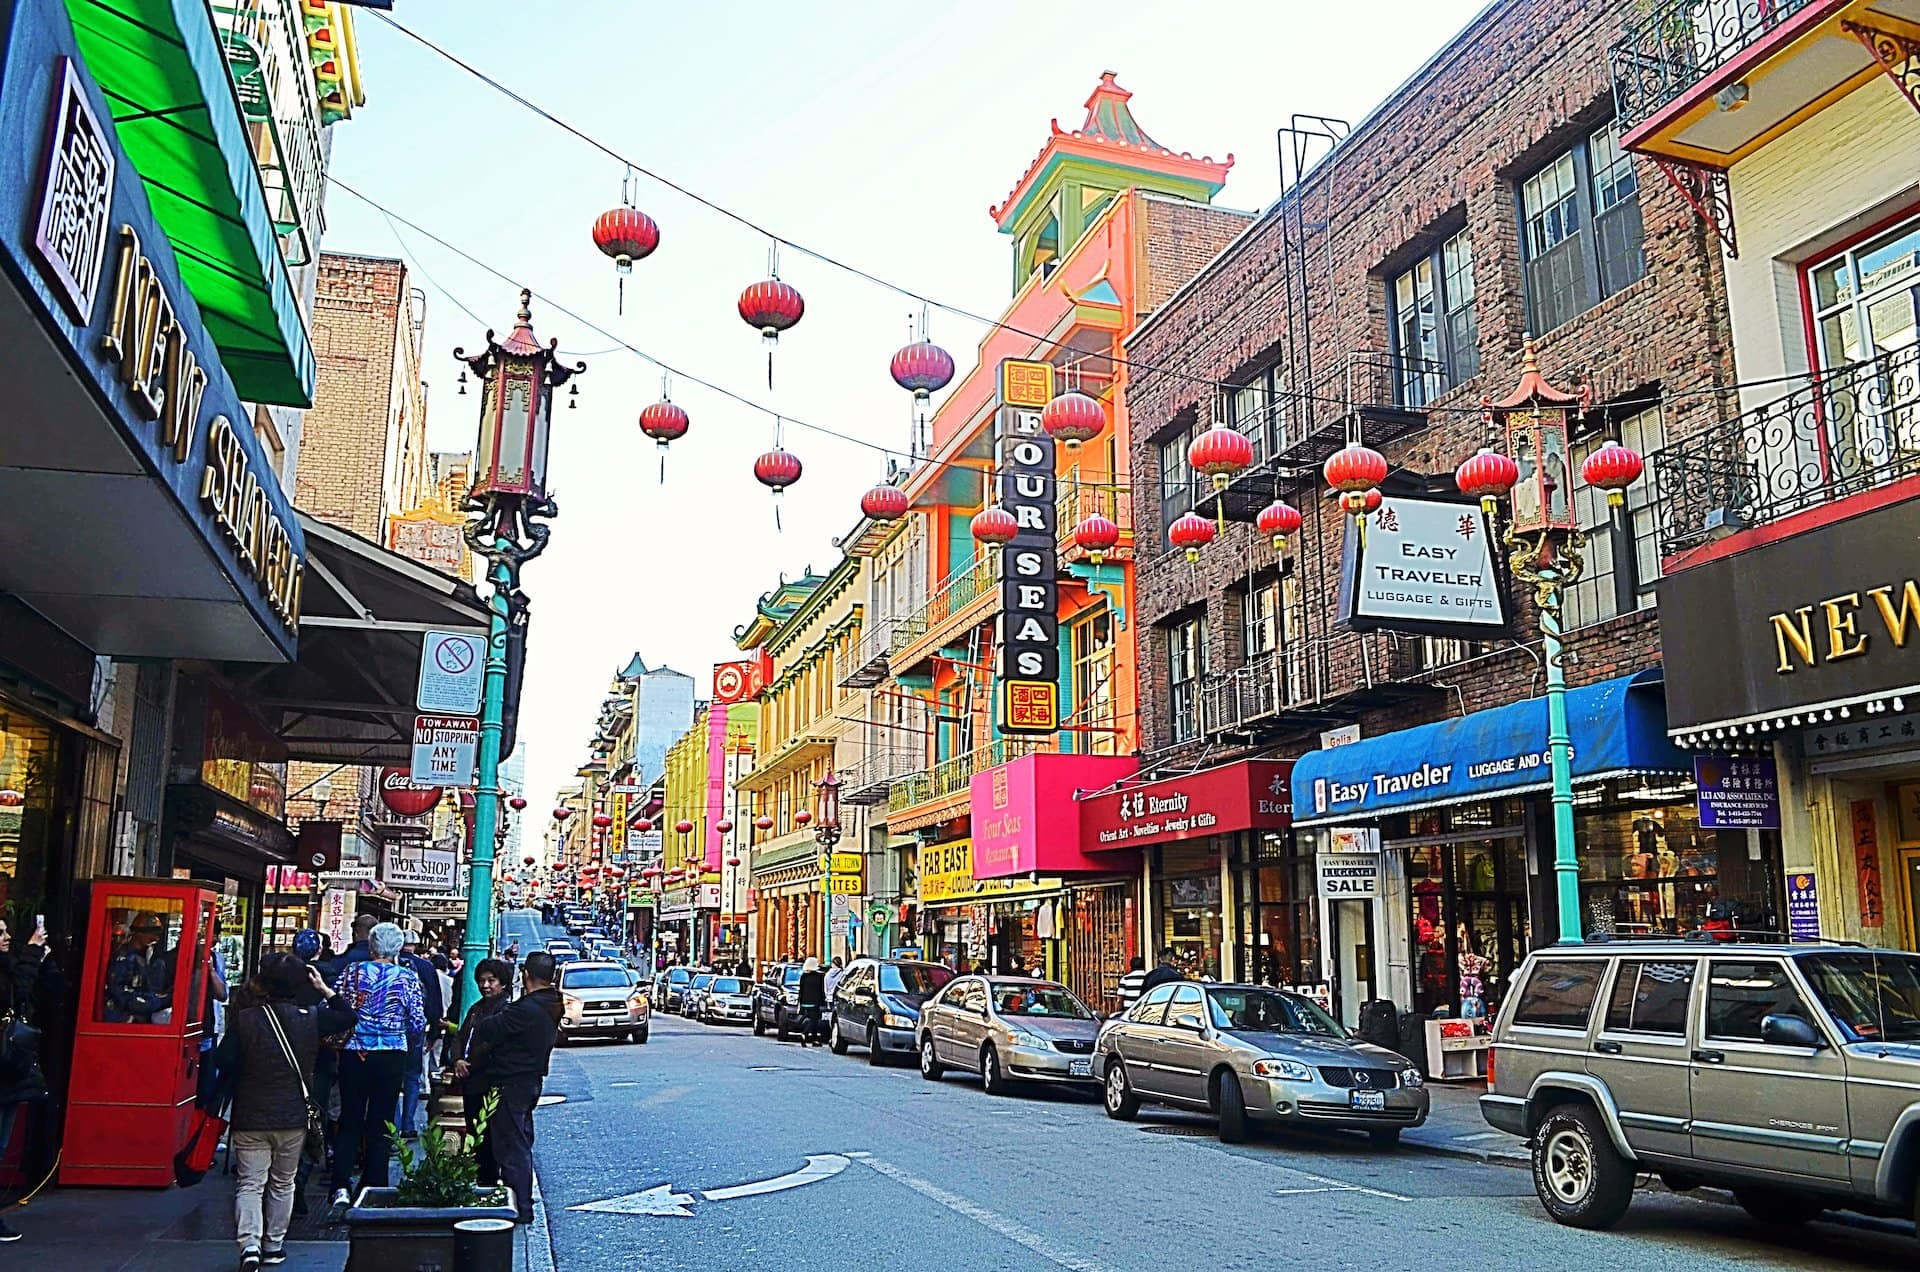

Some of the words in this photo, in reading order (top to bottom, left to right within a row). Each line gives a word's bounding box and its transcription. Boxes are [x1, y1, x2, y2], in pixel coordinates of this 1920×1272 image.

[102, 224, 207, 464] NEW
[1014, 411, 1046, 531] FOUR
[1402, 543, 1457, 560] EASY
[1375, 566, 1482, 587] TRAVELER
[1368, 591, 1433, 604] LUGGAGE
[1440, 595, 1449, 605] &
[1456, 597, 1493, 608] GIFTS
[1016, 552, 1048, 675] SEAS
[422, 718, 473, 729] TOW-AWAY
[415, 728, 431, 743] NO
[435, 730, 475, 744] STOPPING
[433, 746, 457, 758] ANY
[430, 759, 457, 772] TIME
[1469, 759, 1515, 778] LUGGAGE
[1518, 753, 1540, 769] AND
[1330, 780, 1370, 804] Easy
[1373, 764, 1451, 795] Traveler
[1149, 792, 1188, 814] Eternity
[1713, 792, 1726, 800] AND
[1100, 830, 1117, 842] Orient
[1118, 827, 1128, 840] Art
[1133, 821, 1160, 837] Novelties
[1165, 816, 1190, 832] Jewelry
[1190, 816, 1196, 827] &
[1197, 813, 1216, 827] Gifts
[390, 857, 416, 873] WOK
[421, 860, 451, 876] SHOP
[924, 850, 939, 876] FAR
[944, 845, 968, 873] EAST
[324, 869, 372, 878] Commercial
[391, 873, 448, 883] www.wokshop.com
[1324, 868, 1372, 877] LUGGAGE
[1326, 879, 1374, 892] SALE
